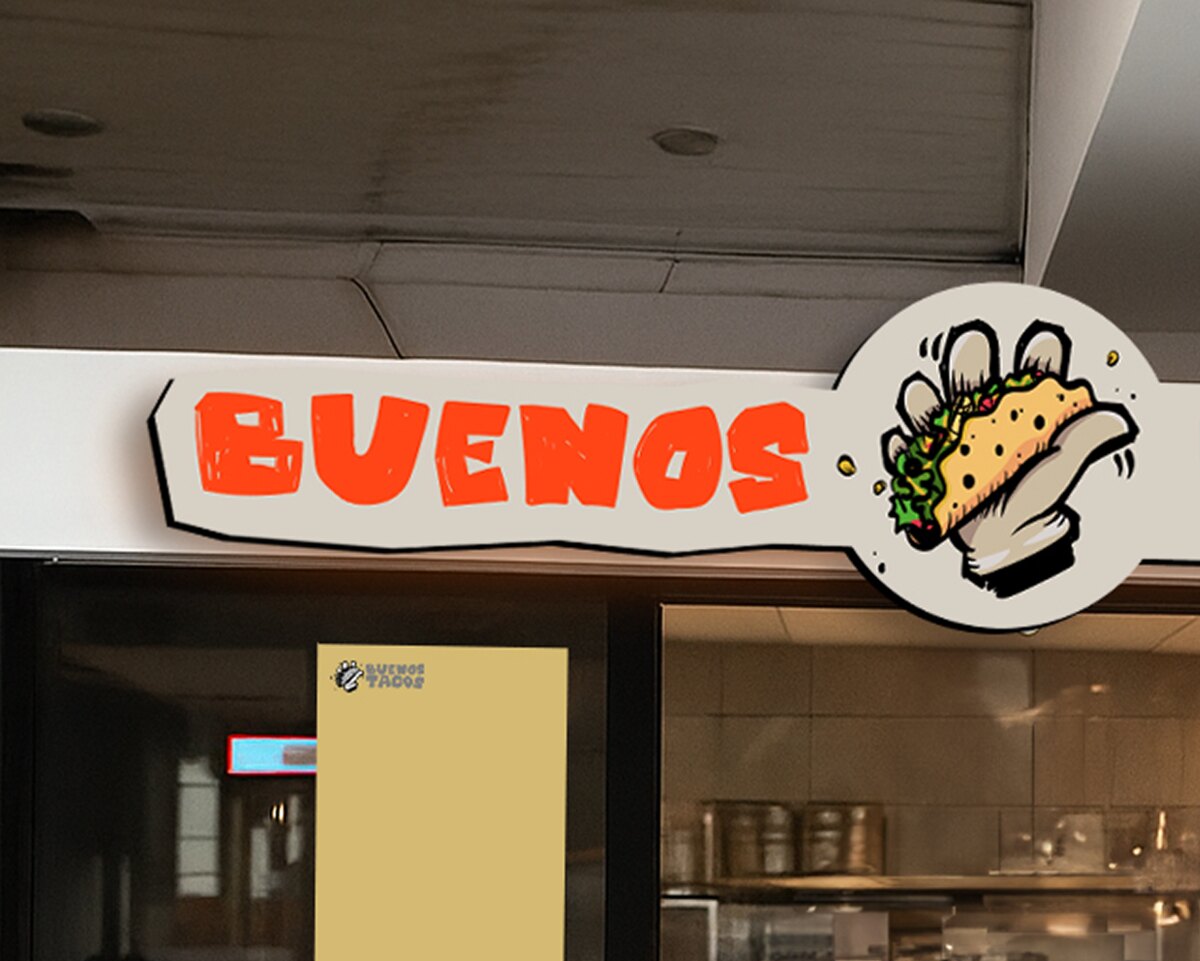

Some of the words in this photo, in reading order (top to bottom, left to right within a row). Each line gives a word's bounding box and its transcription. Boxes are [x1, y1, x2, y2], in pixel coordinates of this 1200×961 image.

[194, 392, 809, 514] BUENOS
[366, 664, 425, 675] BUENOS
[366, 674, 425, 689] TACOS
